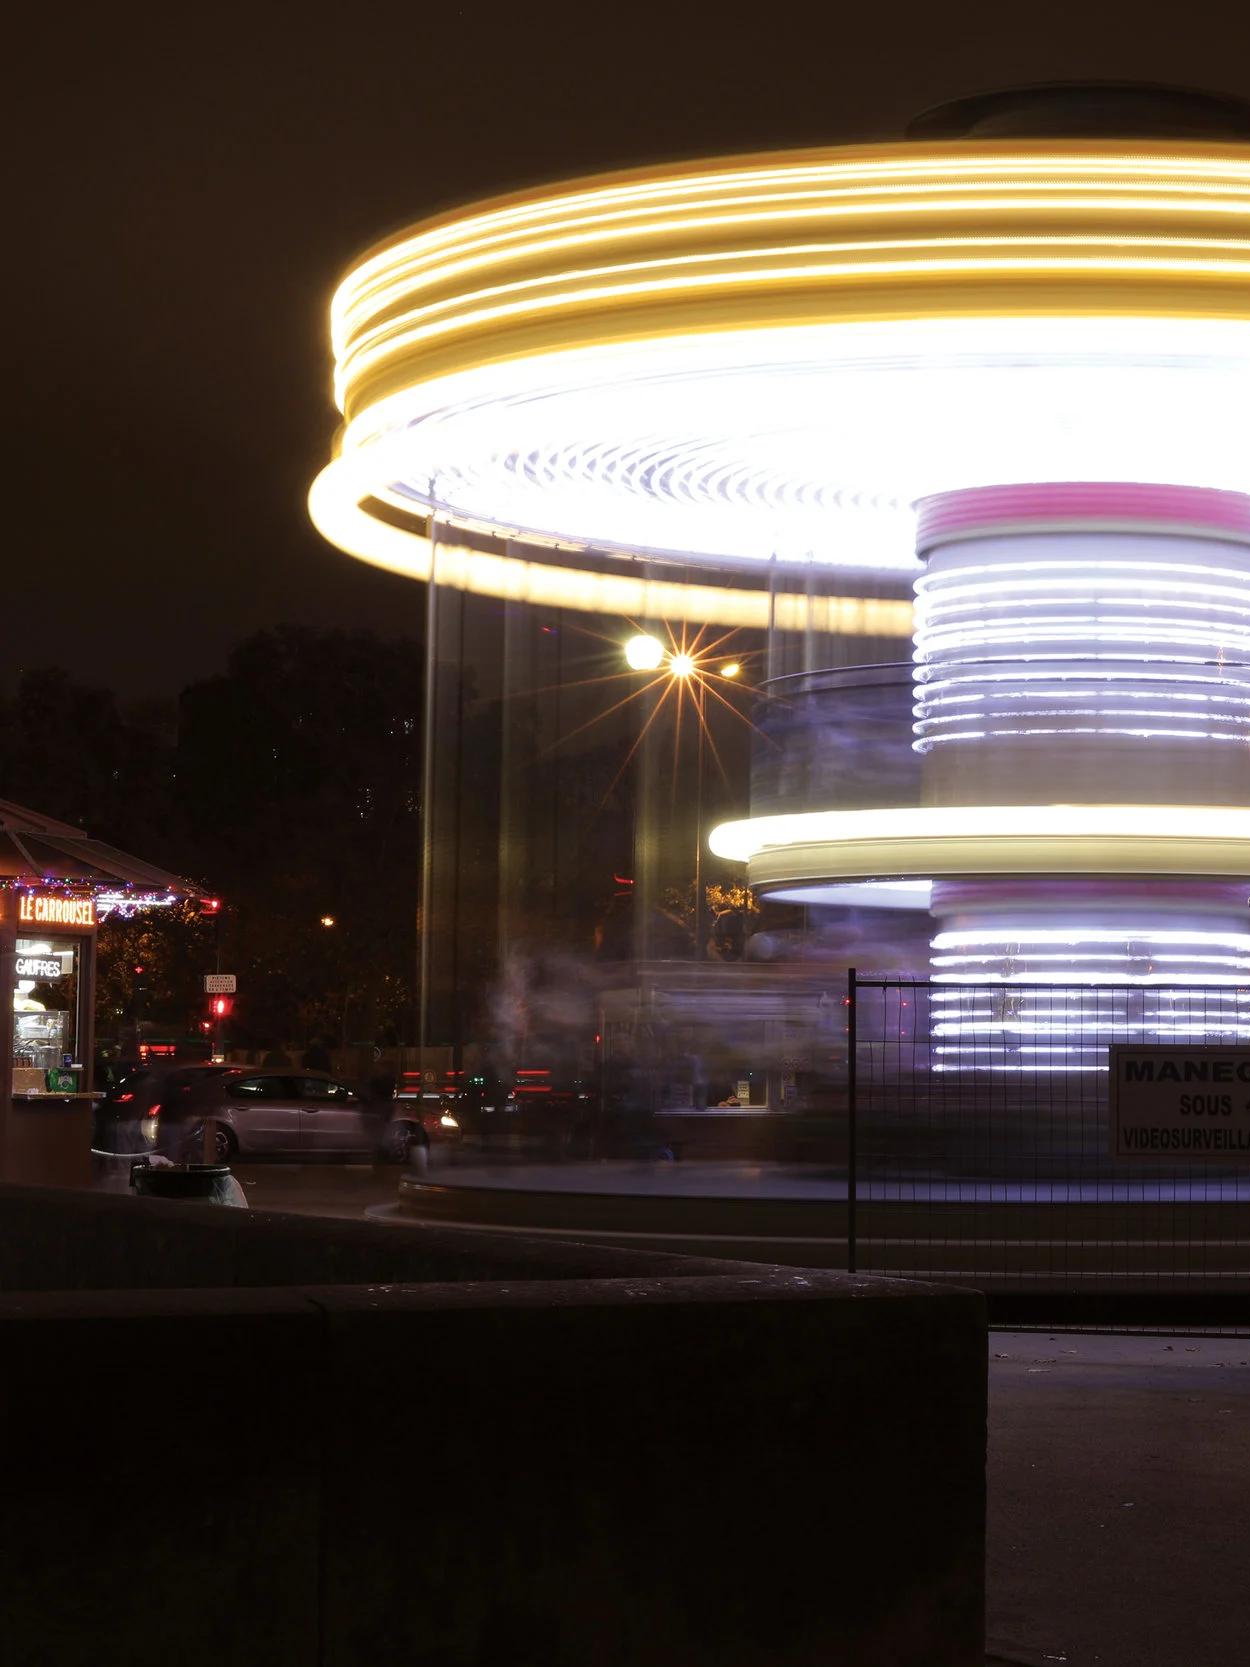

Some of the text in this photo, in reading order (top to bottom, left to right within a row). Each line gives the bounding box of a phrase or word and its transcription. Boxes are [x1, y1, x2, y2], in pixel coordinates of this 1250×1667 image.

[20, 896, 95, 925] LE CARROUSEL
[15, 958, 61, 977] GAUFRES
[1179, 1094, 1233, 1116] SOUS
